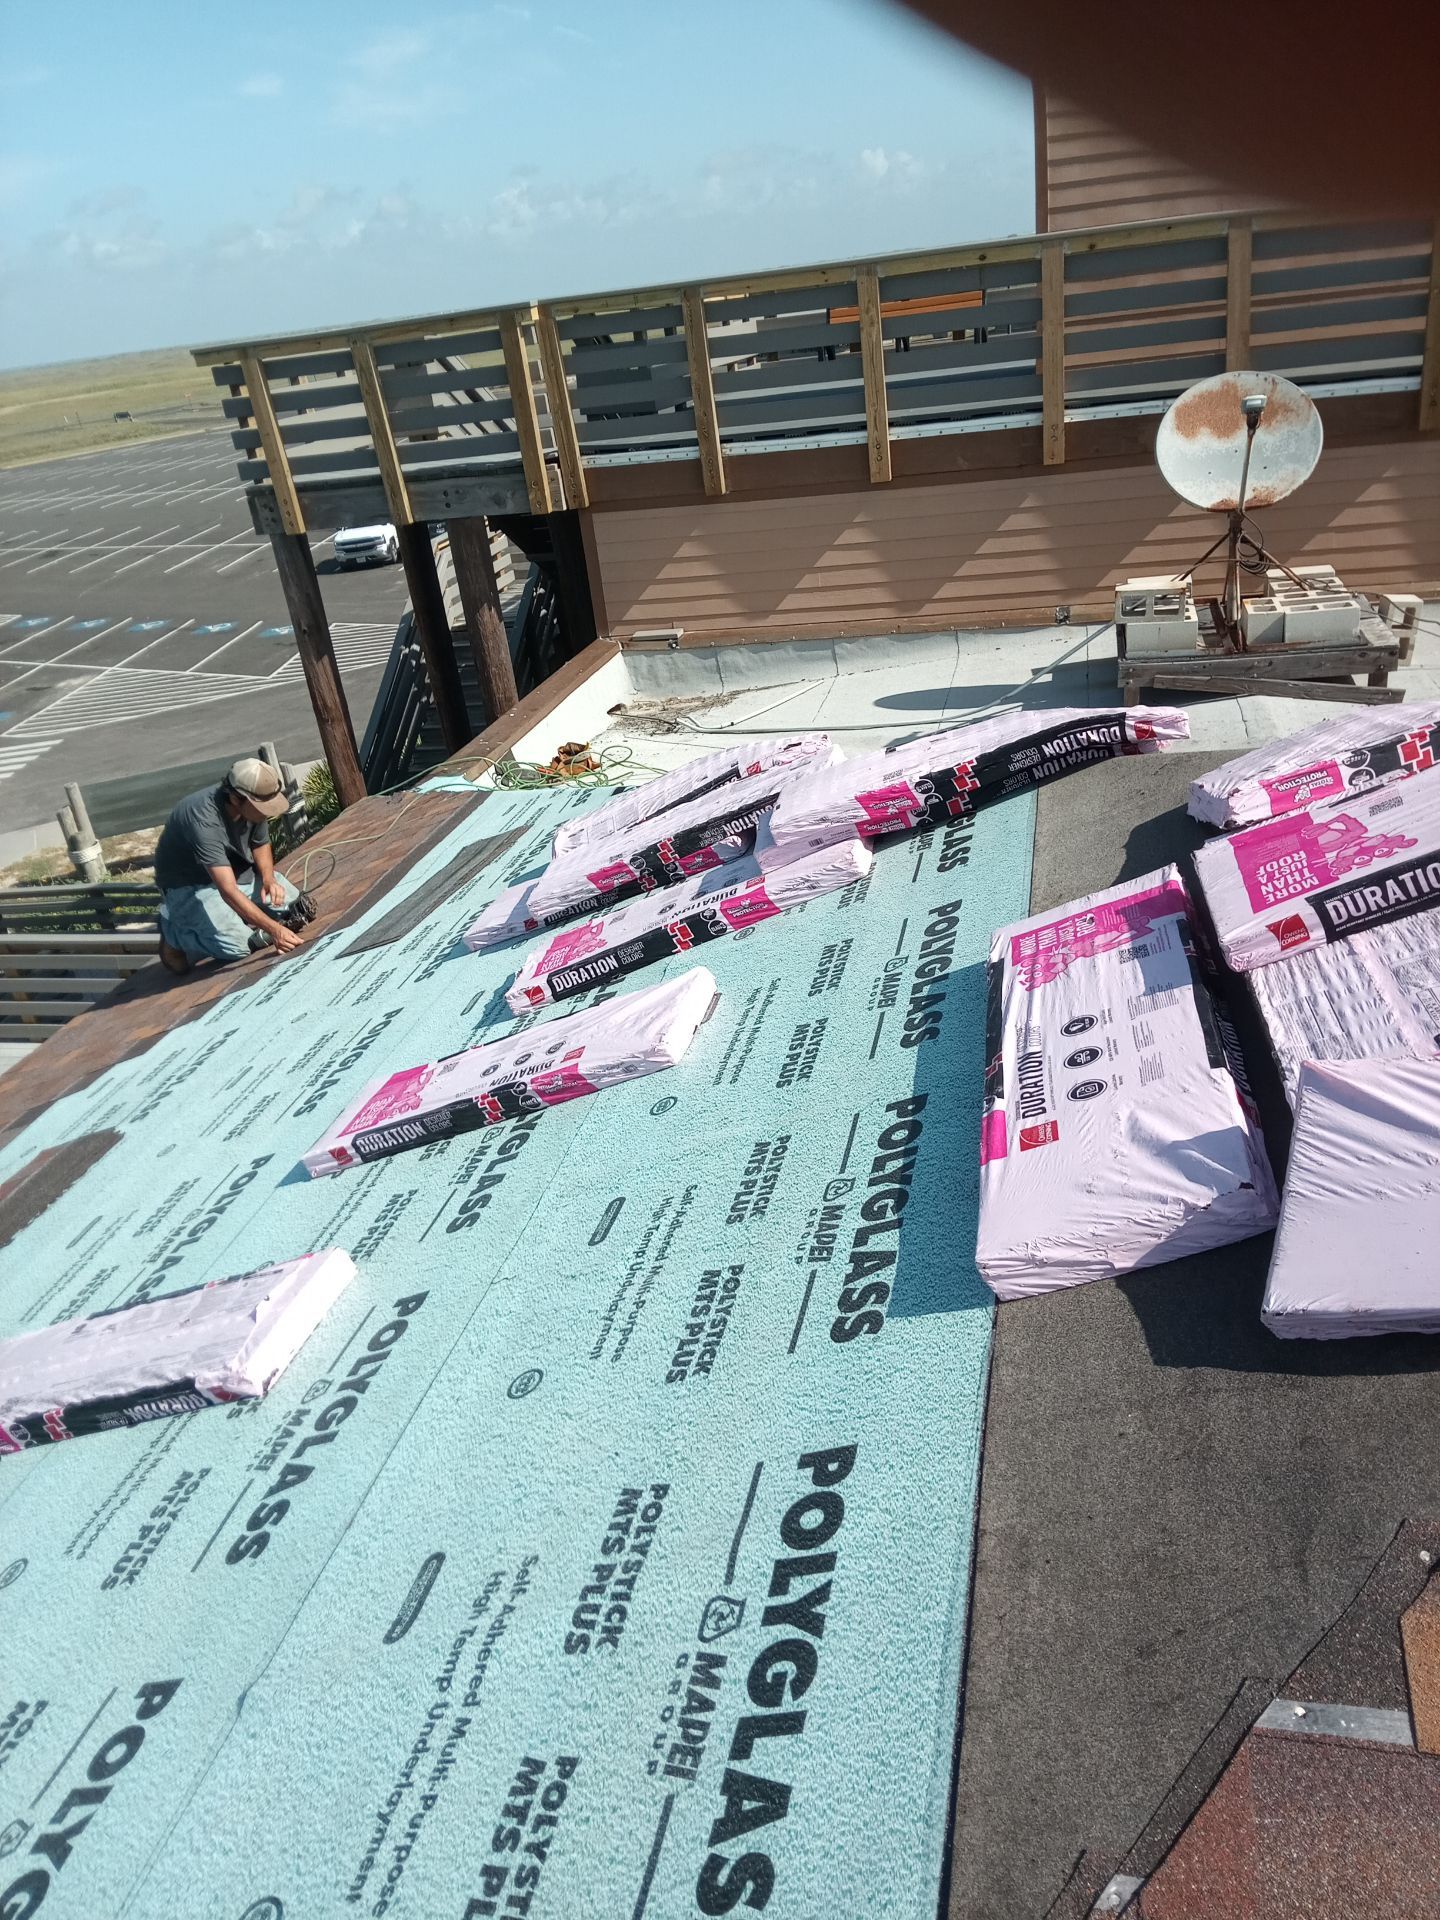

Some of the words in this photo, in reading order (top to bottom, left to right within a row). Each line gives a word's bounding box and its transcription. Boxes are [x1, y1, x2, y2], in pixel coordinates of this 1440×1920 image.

[1009, 754, 1041, 772] DESIGNER
[1010, 748, 1039, 761] COLORS
[1041, 725, 1121, 757] DURATION
[1277, 770, 1328, 792] PROTECTION
[1255, 850, 1308, 874] ROOF
[1258, 875, 1268, 884] A
[1260, 869, 1314, 898] THAN
[1265, 876, 1320, 905] MORE
[1272, 860, 1309, 883] JUST
[1325, 862, 1440, 925] DURATIO
[617, 942, 645, 959] DESIGNER
[621, 951, 645, 966] COLORS
[826, 938, 854, 991] POLYSTICK
[1020, 933, 1037, 957] MORE
[1038, 926, 1057, 950] THAN
[552, 955, 619, 993] DURATION
[900, 899, 963, 1050] POLYGLASS
[293, 1006, 405, 1118] POLYGLASS
[776, 1052, 799, 1089] PLUS
[796, 1017, 829, 1083] POLYSTICK
[1017, 1050, 1047, 1119] DURATION
[356, 1121, 428, 1154] DURATION
[423, 1111, 452, 1127] DESIGNER
[428, 1119, 453, 1133] COLORS
[446, 1111, 545, 1234] YGLASS
[726, 1178, 756, 1225] PLUS
[749, 1134, 792, 1219] POLYSTICK
[659, 1184, 698, 1262] Self-Adhered
[808, 1204, 847, 1262] MAPEI
[830, 1092, 929, 1344] POLYGLASS
[590, 1260, 644, 1361] Underlayment
[611, 1262, 661, 1363] Multi-Purpose
[692, 1264, 746, 1377] POLYSTICK
[694, 1269, 723, 1317] MTS
[665, 1321, 701, 1385] PLUS
[225, 1290, 431, 1566] POLYGLASS
[253, 1408, 312, 1472] MAPEI
[149, 1469, 194, 1519] MTS
[601, 1486, 644, 1558] MTS
[100, 1523, 154, 1591] PLUS
[119, 1467, 212, 1588] POLYSTICK
[468, 1570, 507, 1621] High
[594, 1483, 670, 1651] POLYSTICK
[463, 1555, 539, 1710] Self-Adhered
[563, 1563, 618, 1657] PLUS
[437, 1625, 478, 1693] Temp
[694, 1442, 859, 1920] POLYGLAS
[662, 1651, 728, 1782] MAPEI
[0, 1677, 185, 1920] POLYG
[346, 1701, 450, 1904] Underlayment
[372, 1716, 472, 1919] Multi-Purpose
[491, 1756, 548, 1854] MTS
[500, 1756, 581, 1920] POLYST
[463, 1864, 510, 1920] PL
